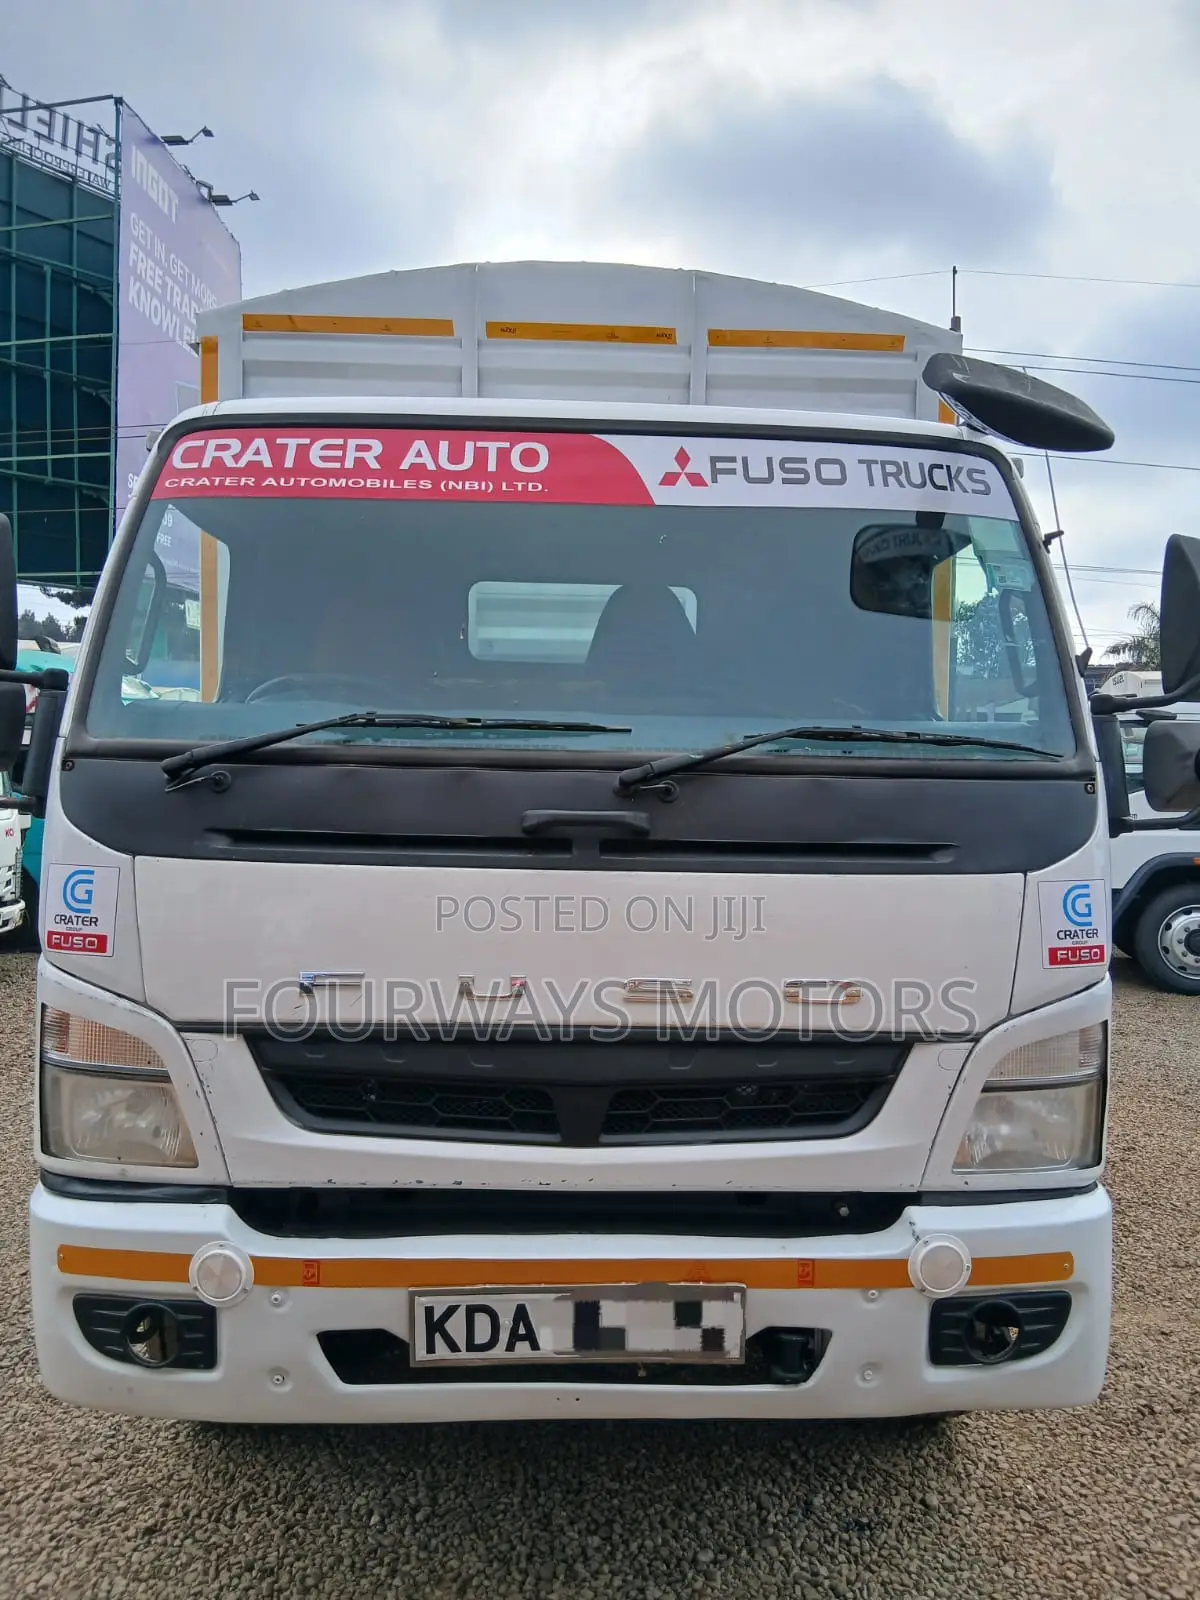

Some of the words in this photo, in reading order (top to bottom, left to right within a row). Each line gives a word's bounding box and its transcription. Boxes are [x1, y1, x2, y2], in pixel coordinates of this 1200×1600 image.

[130, 212, 153, 250] GET
[169, 253, 190, 288] GET
[129, 240, 163, 294] FREE
[172, 437, 383, 470] CRATER
[399, 439, 550, 474] AUTO
[709, 455, 848, 486] FUSO
[857, 458, 992, 496] TRUCKS
[164, 476, 256, 488] CRATER
[261, 477, 433, 489] AUTOMOBILES
[440, 479, 494, 493] (NBI)
[502, 481, 549, 492] LTD.
[54, 914, 98, 927] CRATER
[51, 934, 98, 949] FUSO
[1056, 928, 1099, 940] CRATER
[1057, 948, 1101, 962] FUSO
